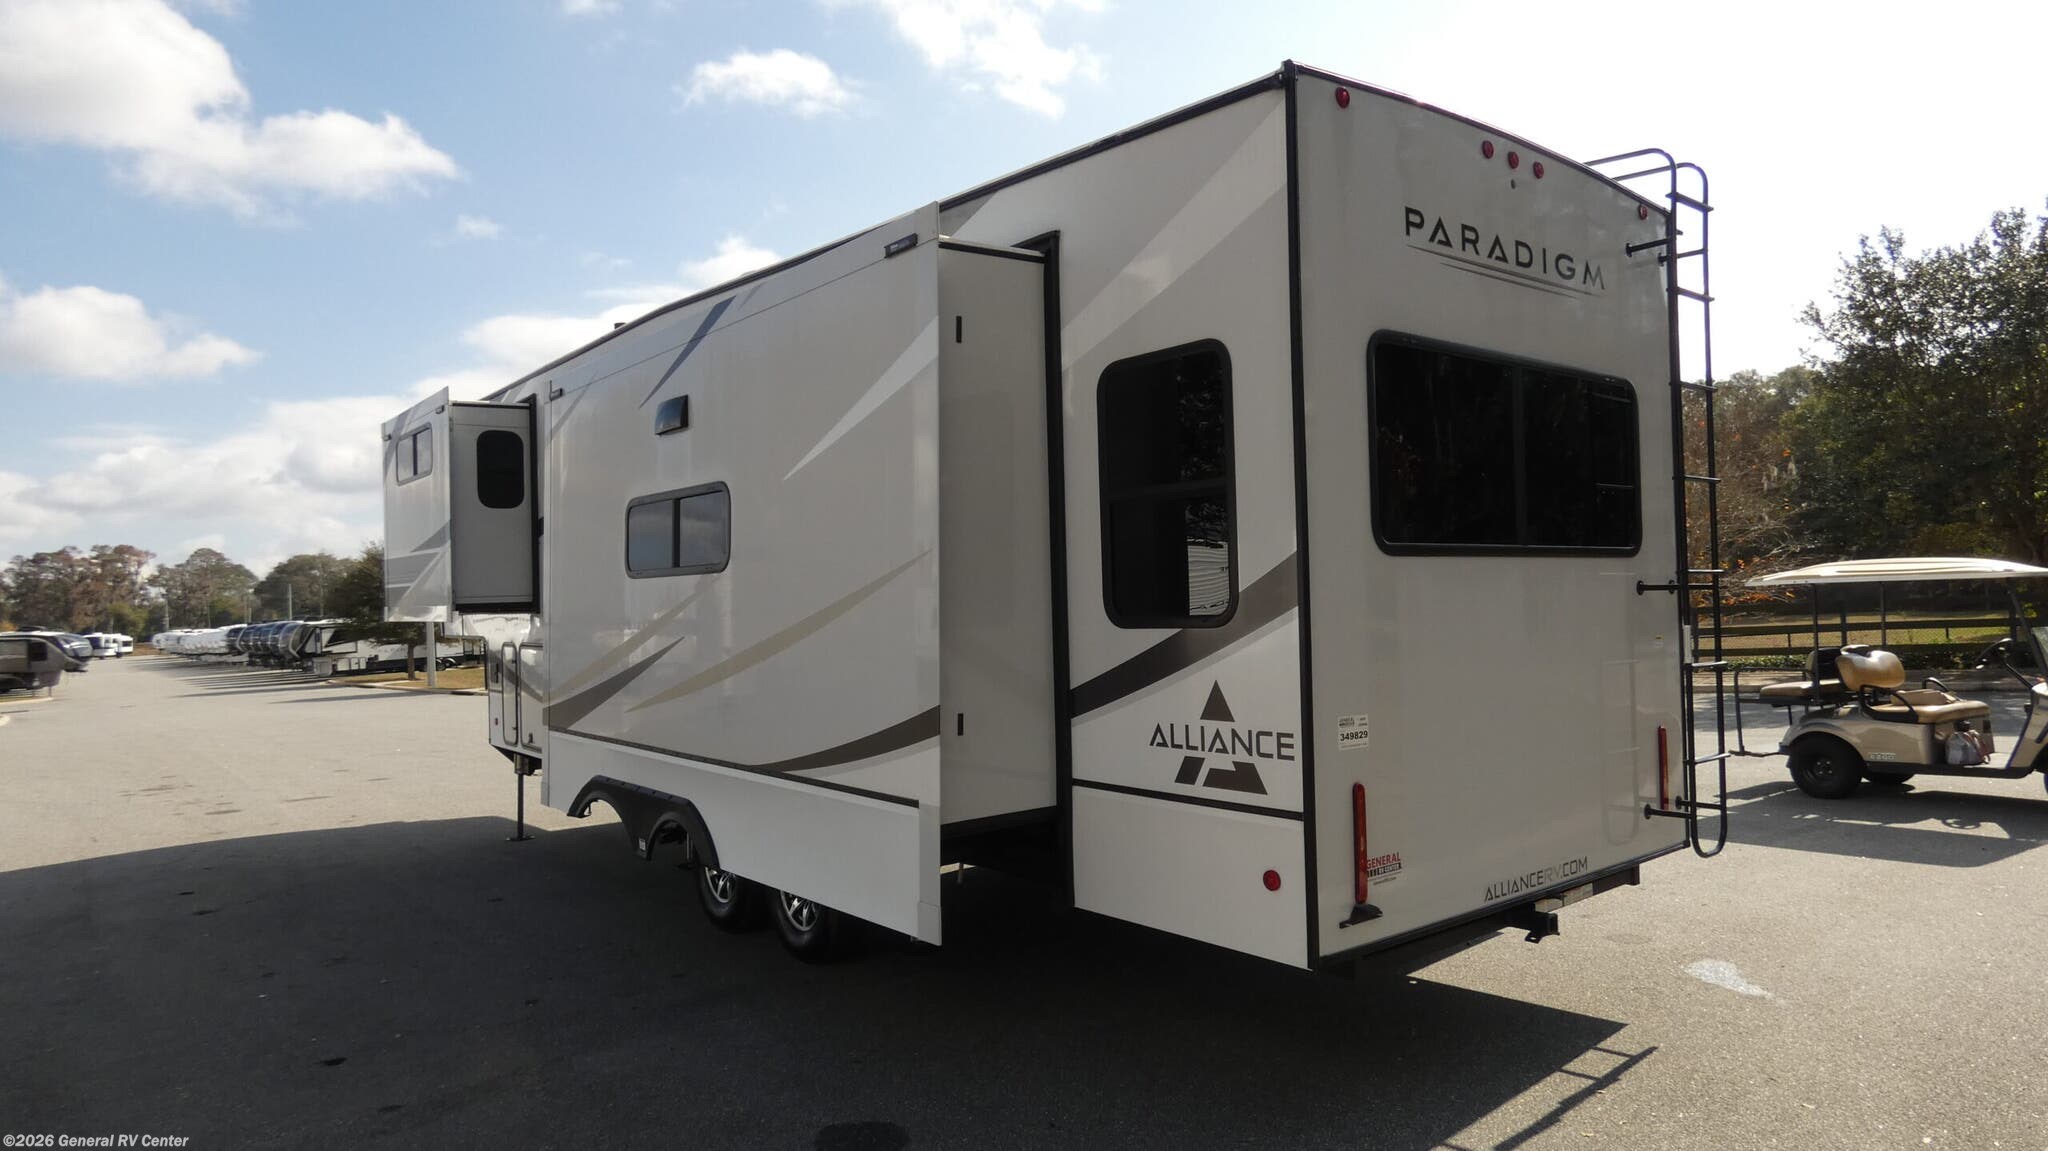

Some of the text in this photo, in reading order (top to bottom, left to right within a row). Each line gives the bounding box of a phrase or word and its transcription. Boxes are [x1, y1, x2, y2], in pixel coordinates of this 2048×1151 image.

[1404, 206, 1605, 290] PARADIGM
[1149, 722, 1295, 761] ALLIANCE
[1340, 730, 1368, 741] 349829
[1367, 852, 1401, 869] GENERAL
[1484, 856, 1588, 902] ALLIANCERV.COM
